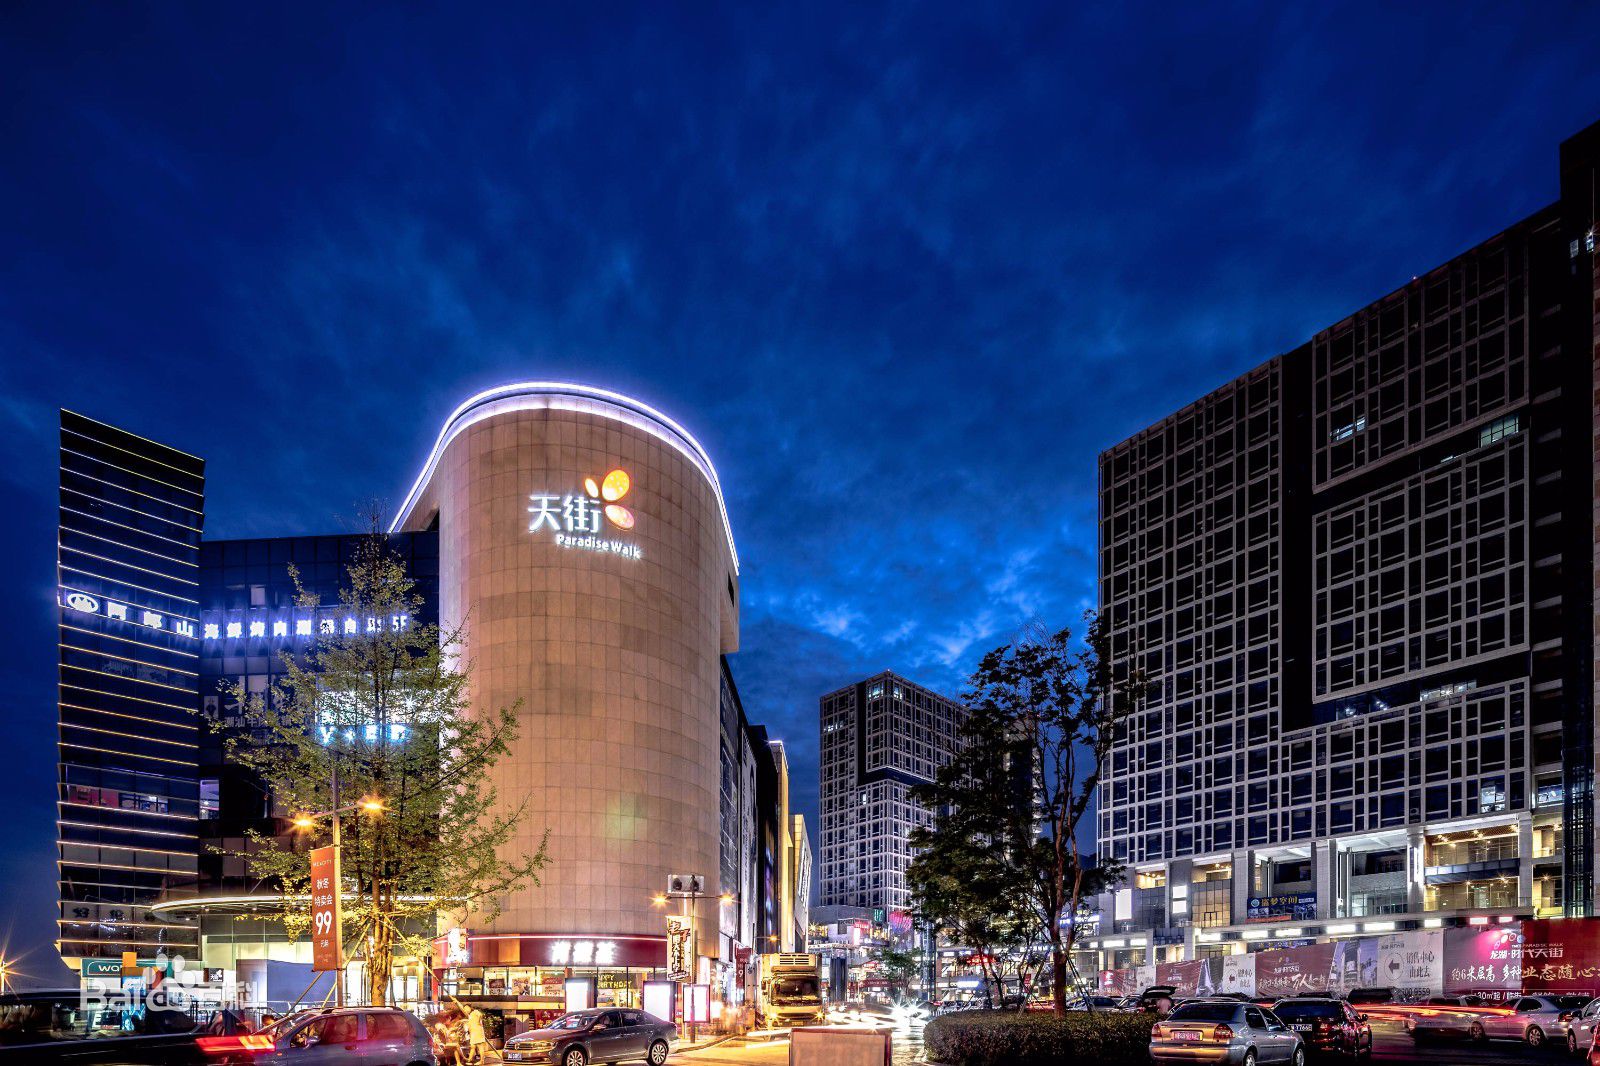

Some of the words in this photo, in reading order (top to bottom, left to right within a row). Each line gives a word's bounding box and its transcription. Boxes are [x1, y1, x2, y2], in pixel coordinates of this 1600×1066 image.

[528, 495, 602, 533] 天街
[556, 533, 609, 551] Paradise
[610, 541, 641, 560] Walk
[314, 894, 333, 907] 特卖会
[315, 910, 333, 935] 99
[1501, 963, 1600, 982] 多种业态随心
